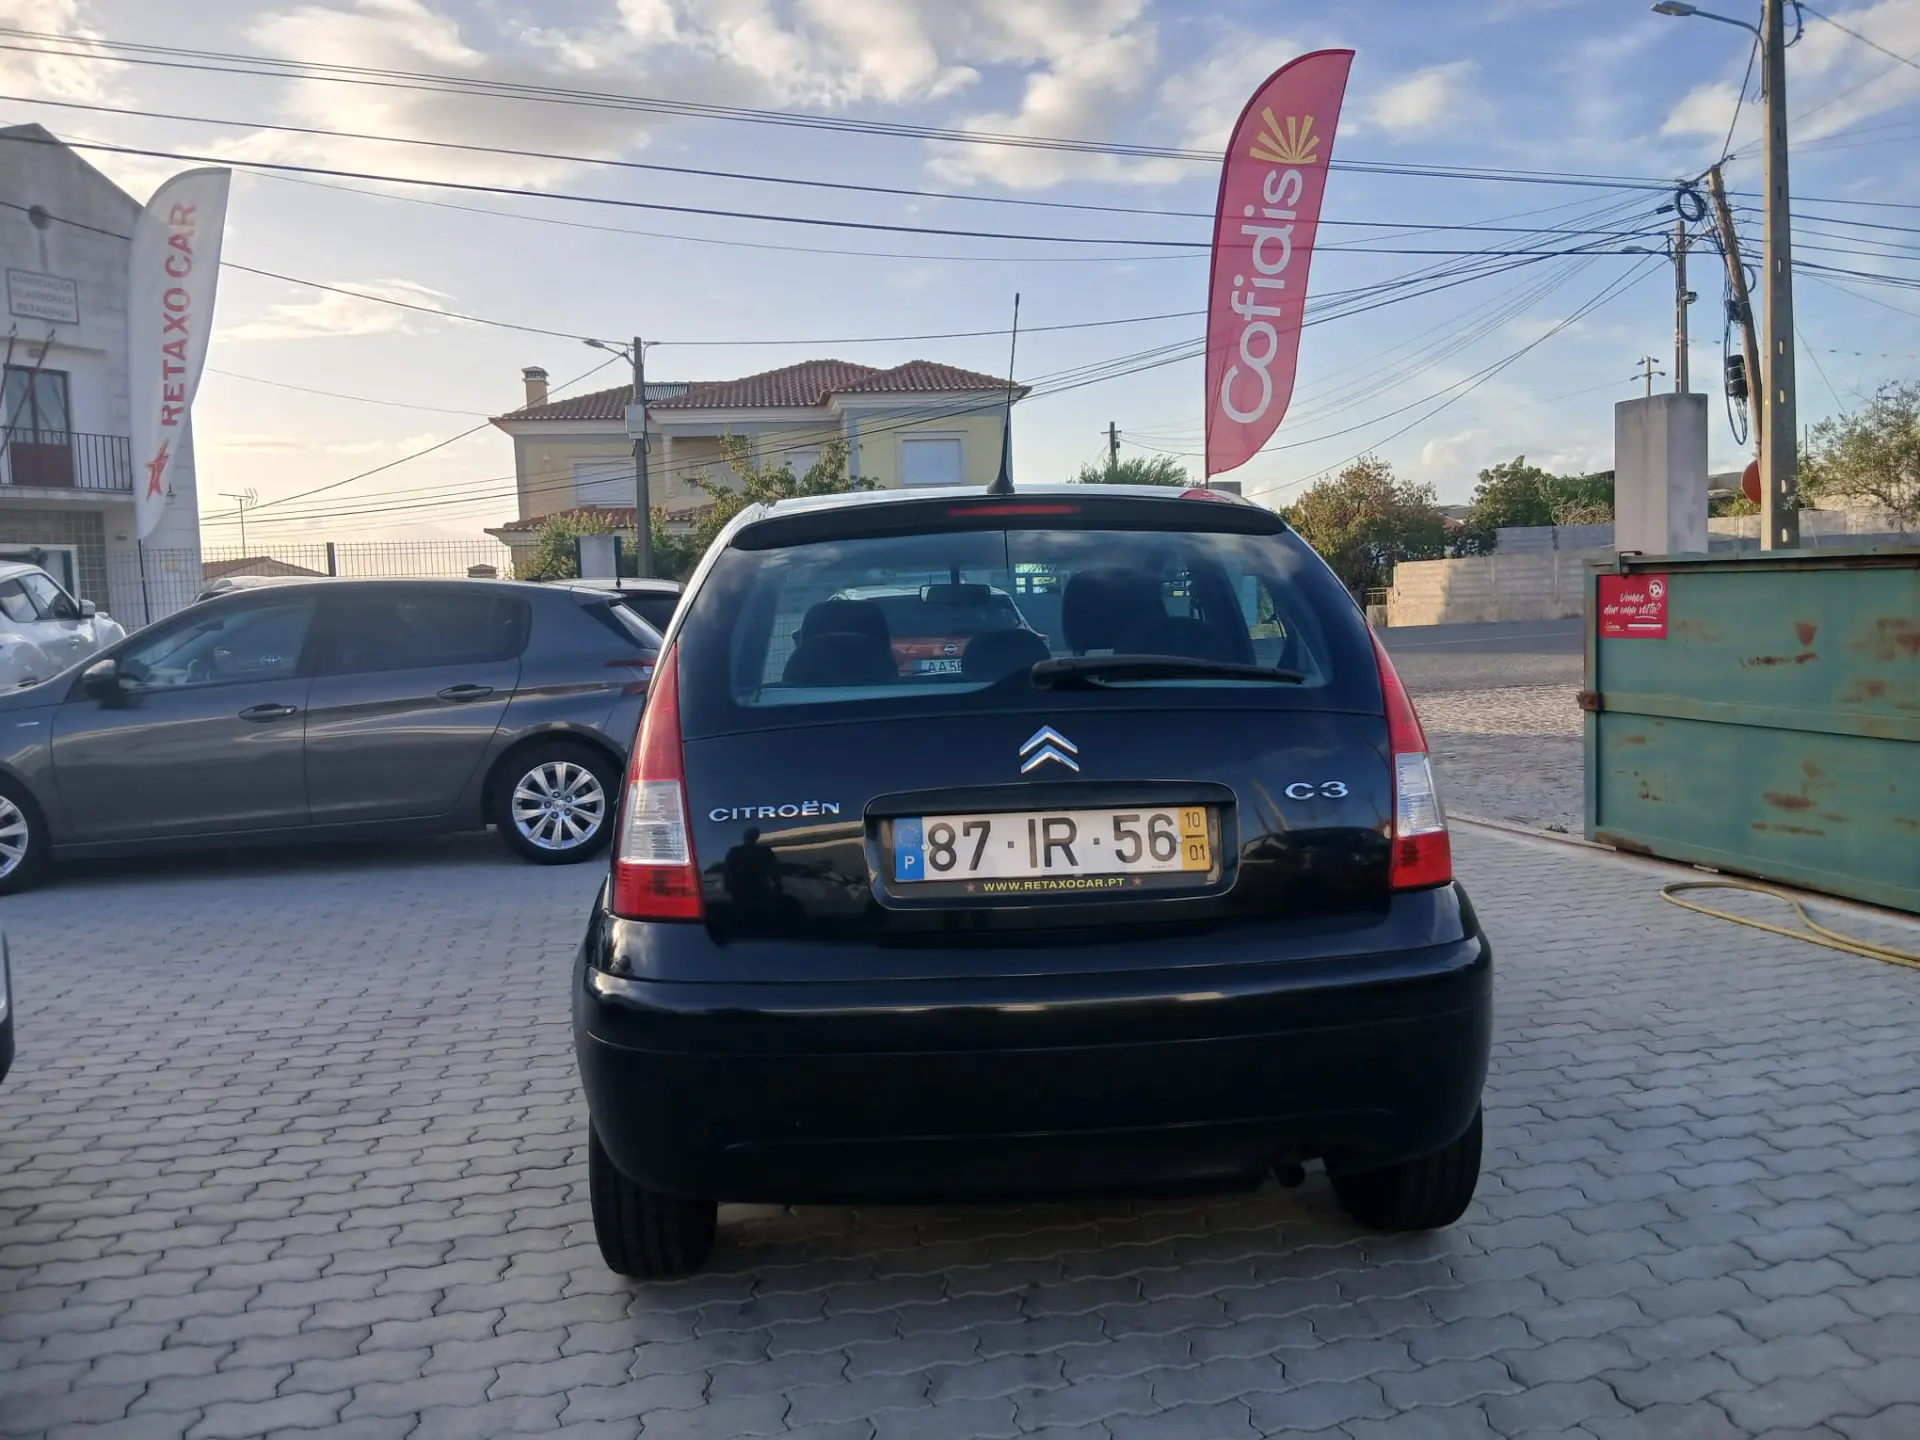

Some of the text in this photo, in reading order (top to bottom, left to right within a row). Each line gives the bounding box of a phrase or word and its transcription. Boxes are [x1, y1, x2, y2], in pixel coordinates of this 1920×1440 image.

[1221, 169, 1303, 424] Cofidis
[161, 202, 197, 427] RETAXO CAR
[1603, 604, 1619, 616] dar
[1285, 780, 1349, 800] C3
[708, 800, 841, 822] CITROËN
[1185, 811, 1201, 828] 10
[904, 813, 1177, 871] P 87 IR 56
[1189, 844, 1206, 861] 01
[983, 877, 1125, 892] WWW.RETAXOCAR.PT
